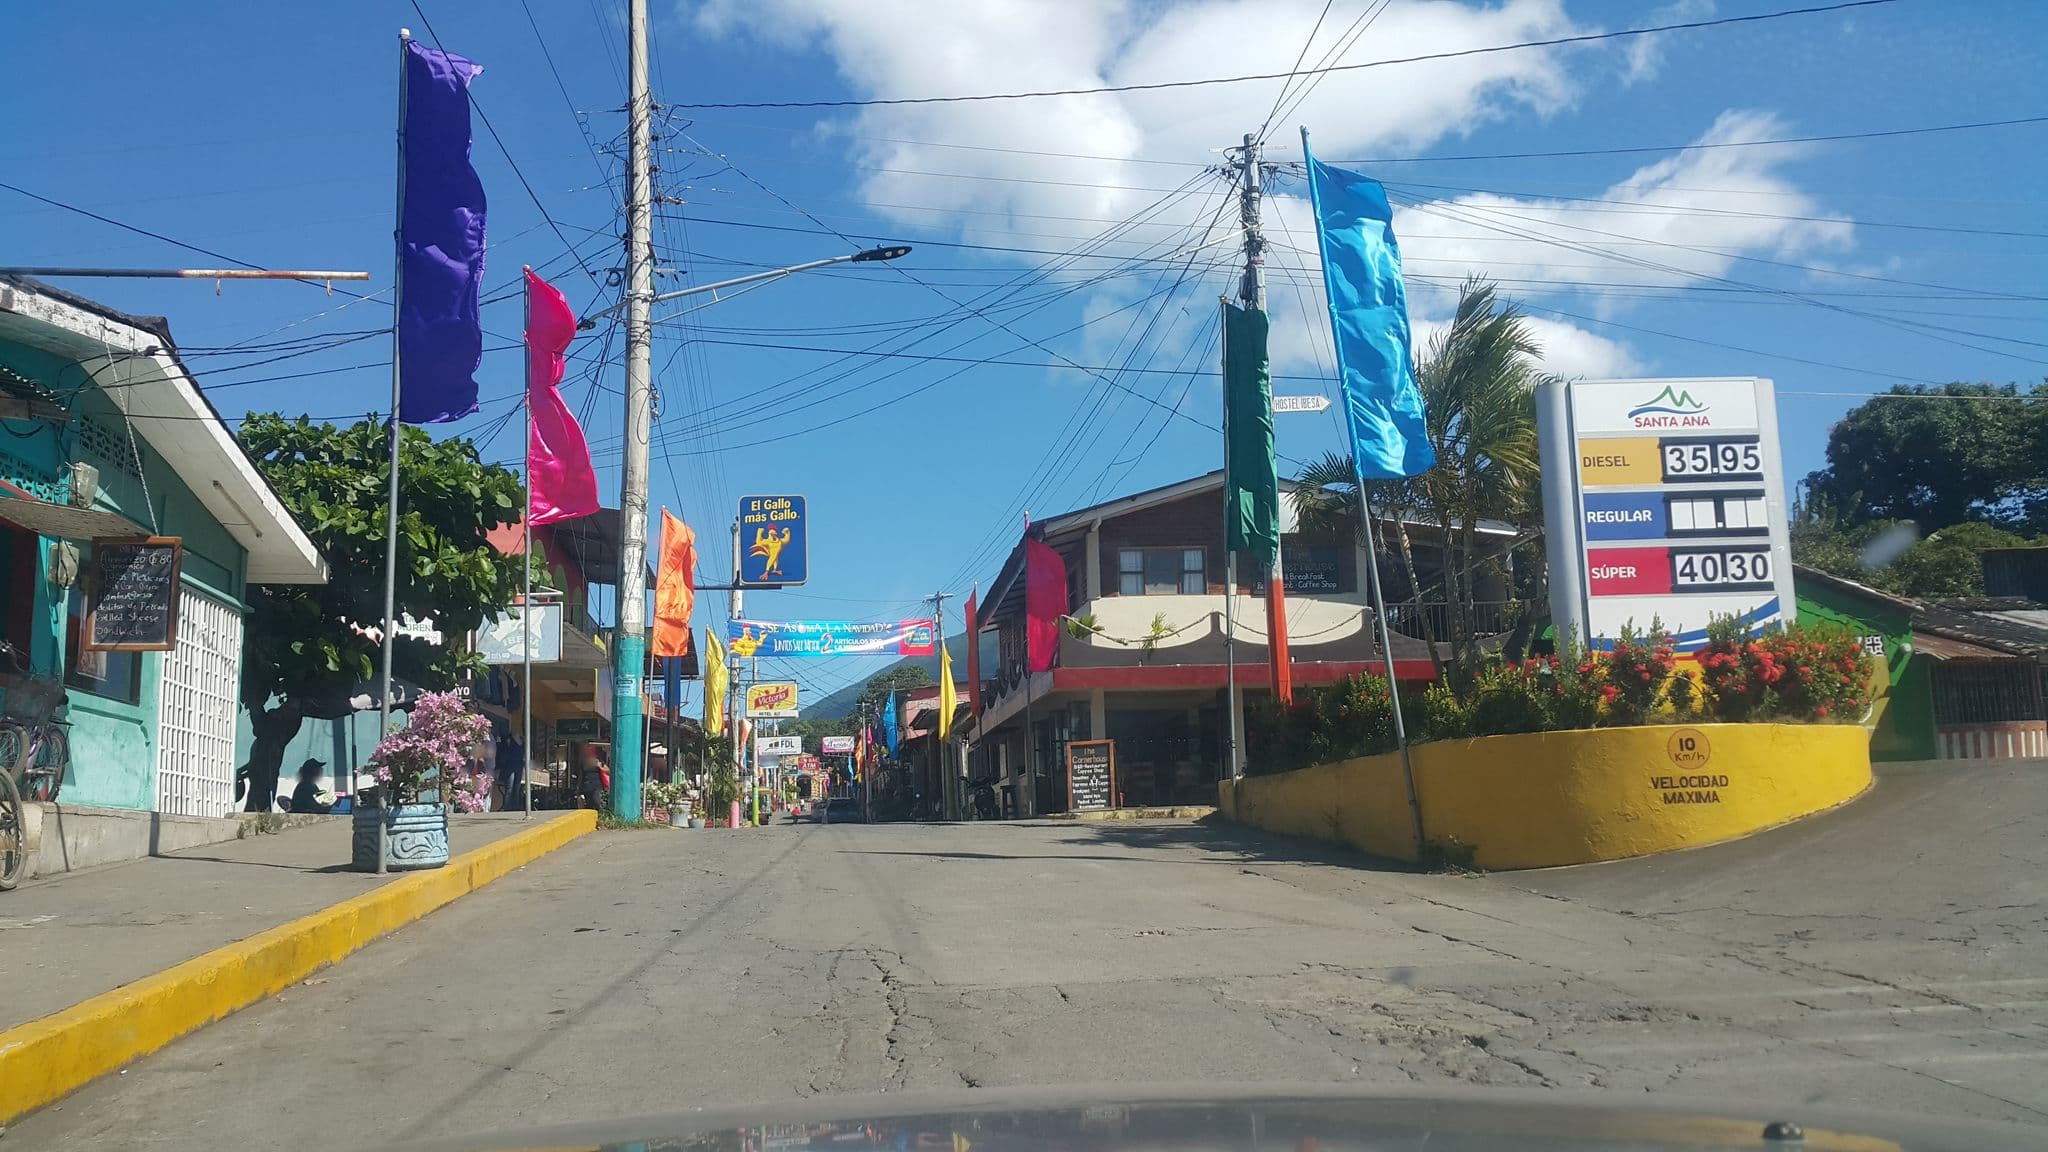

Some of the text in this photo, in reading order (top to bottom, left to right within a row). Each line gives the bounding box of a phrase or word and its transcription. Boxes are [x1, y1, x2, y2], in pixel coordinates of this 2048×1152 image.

[1275, 397, 1320, 410] HOSTEL IBESA
[1635, 415, 1711, 428] SANTA ANA
[1583, 456, 1630, 468] DIESEL
[751, 498, 791, 511] El Gallo
[745, 509, 797, 523] más Gallo
[1586, 509, 1652, 523] REGULAR
[1591, 564, 1637, 580] SÚPER
[1321, 580, 1337, 590] Shop
[768, 623, 779, 633] SE
[821, 632, 833, 654] 2
[758, 692, 786, 705] Victoria
[780, 739, 795, 748] FDL
[1679, 737, 1696, 752] 10
[1651, 774, 1729, 789] VELOCIDAD
[1663, 790, 1721, 805] MAXIMA
